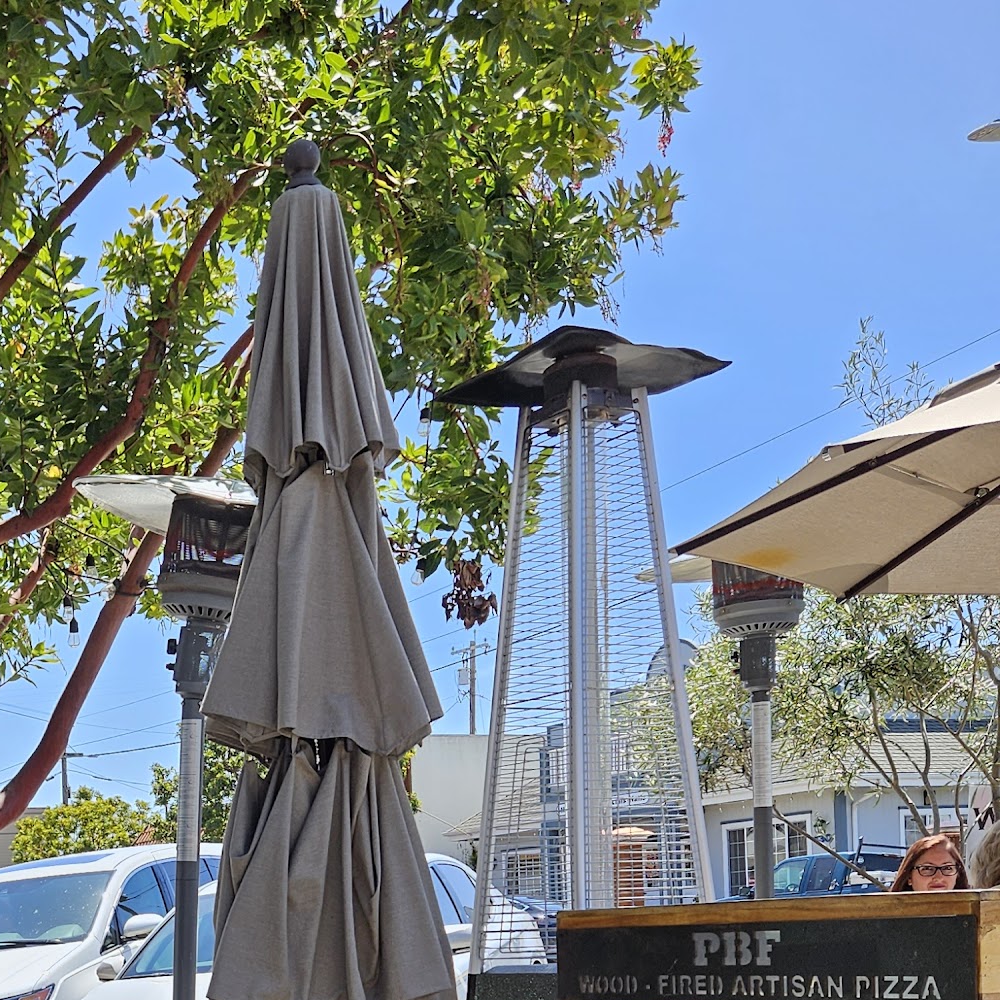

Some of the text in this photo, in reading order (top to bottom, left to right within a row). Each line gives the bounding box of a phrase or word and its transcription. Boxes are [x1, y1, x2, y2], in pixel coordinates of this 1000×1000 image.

[692, 930, 781, 967] PBF
[579, 974, 638, 994] WOOD
[658, 974, 723, 996] FIRED
[732, 975, 844, 998] ARTISAN
[855, 975, 942, 1000] PIZZA
